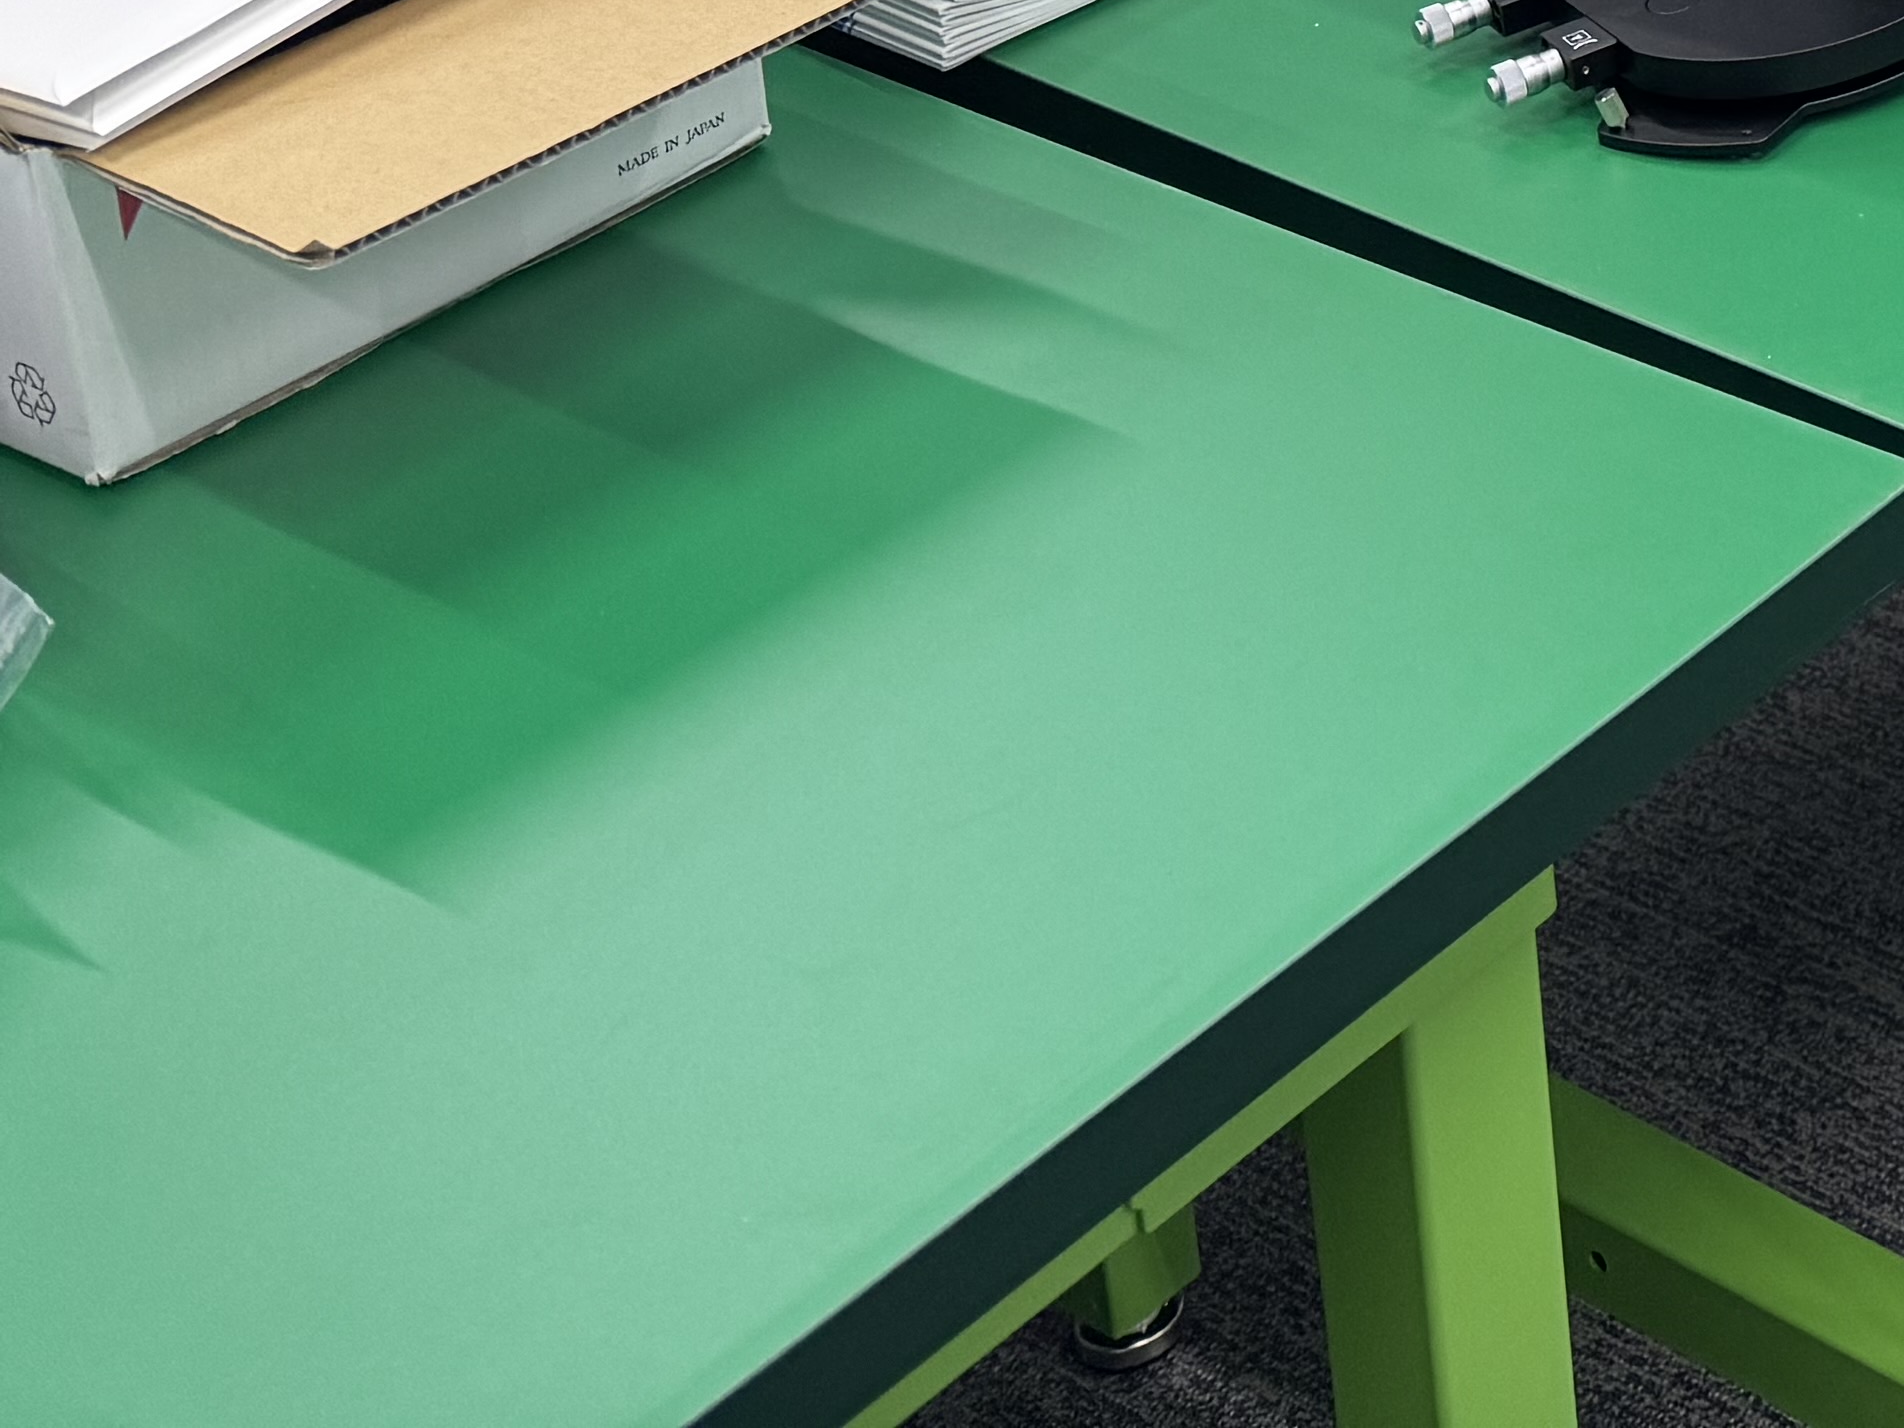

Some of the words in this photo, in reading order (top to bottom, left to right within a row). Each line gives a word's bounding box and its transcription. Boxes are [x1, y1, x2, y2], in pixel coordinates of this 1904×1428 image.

[617, 146, 660, 177] MADE
[664, 135, 680, 154] IN
[685, 111, 726, 145] JAPAN
